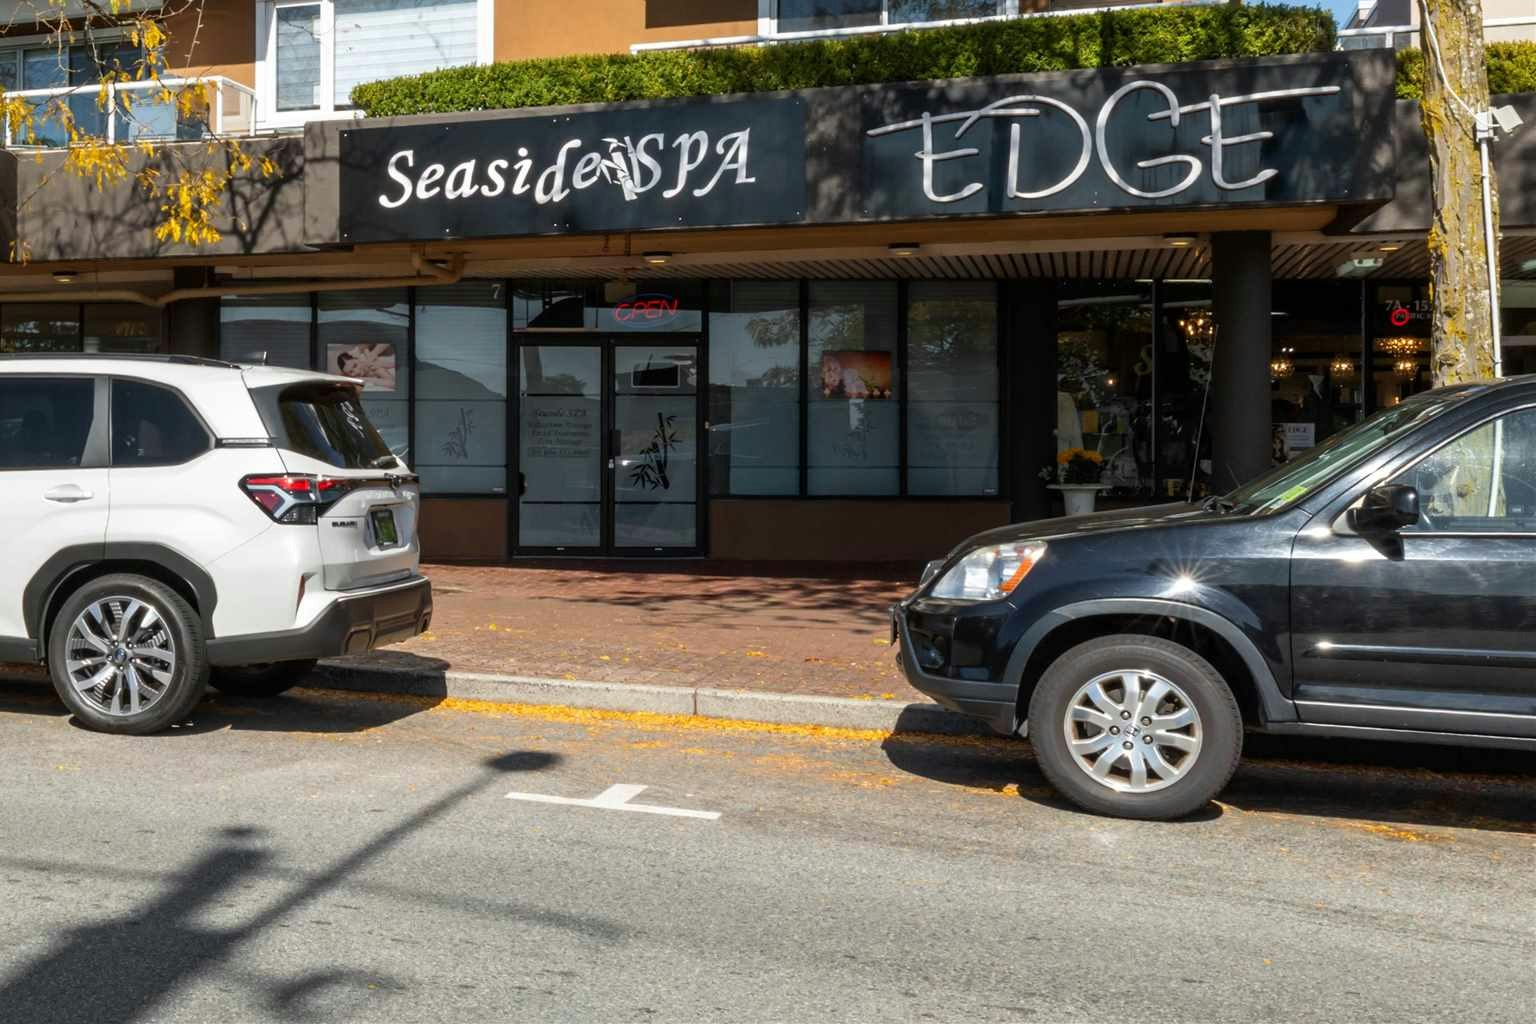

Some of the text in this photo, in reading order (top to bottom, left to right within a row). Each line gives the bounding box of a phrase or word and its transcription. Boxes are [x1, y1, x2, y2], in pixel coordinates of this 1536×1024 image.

[865, 79, 1341, 203] EDGE
[378, 127, 757, 209] Seaside SPA
[491, 283, 501, 300] 7
[614, 298, 680, 321] OPEN
[1415, 299, 1434, 312] 15
